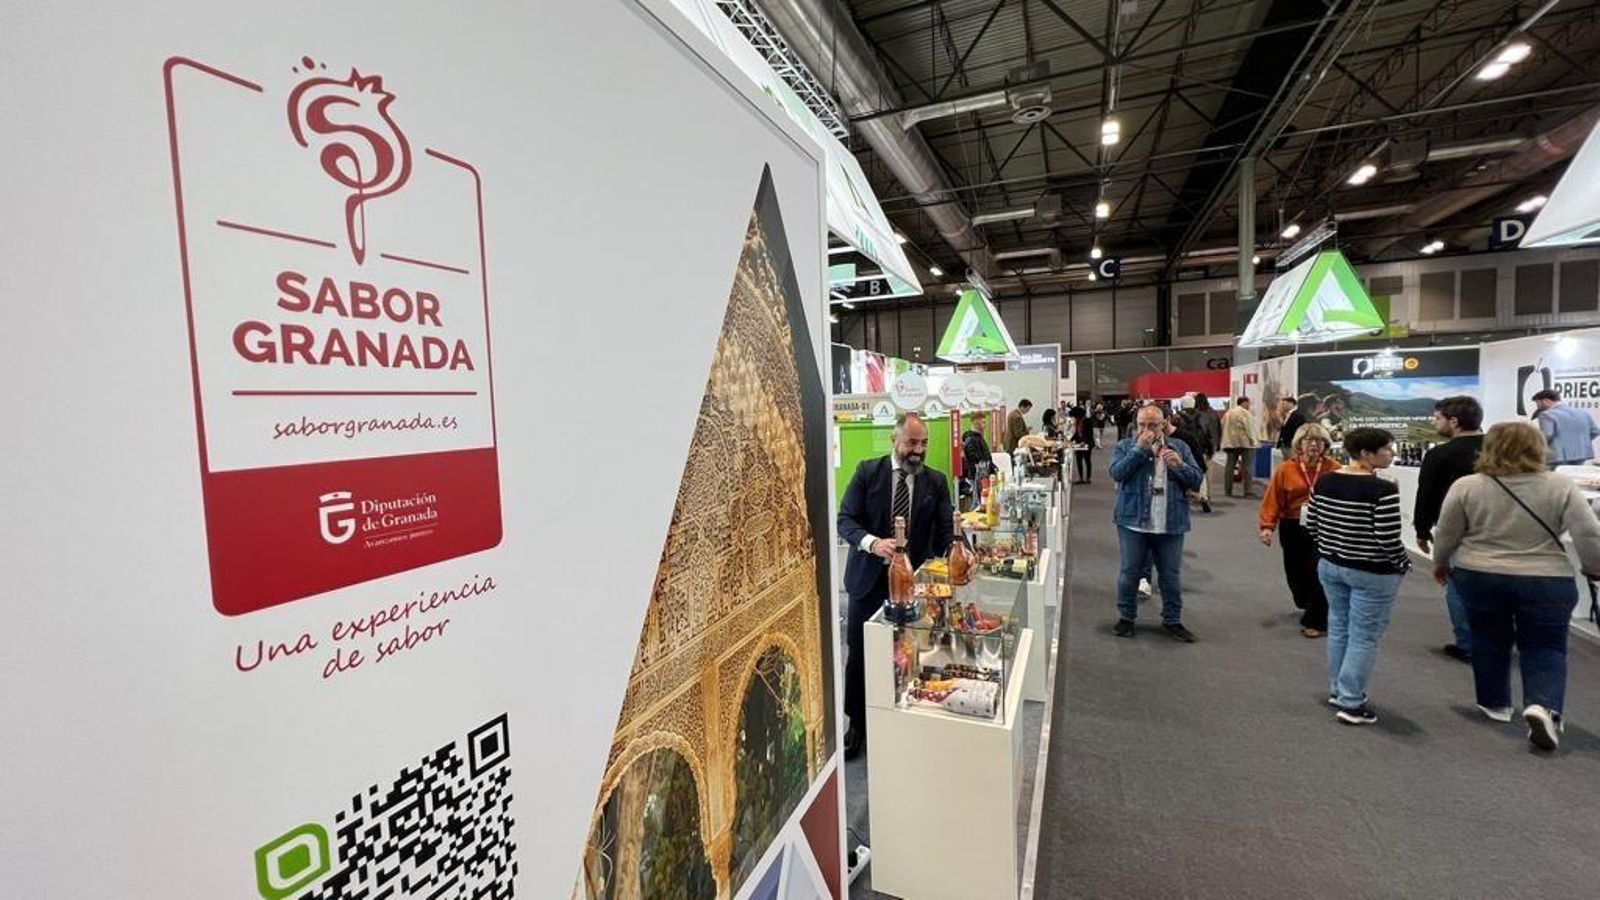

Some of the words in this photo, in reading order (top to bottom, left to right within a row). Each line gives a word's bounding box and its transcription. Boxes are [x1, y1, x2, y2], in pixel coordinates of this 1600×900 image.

[1500, 219, 1524, 242] D
[1099, 258, 1115, 278] C
[276, 271, 442, 328] SABOR
[869, 280, 881, 295] B
[232, 320, 475, 371] GRANADA
[274, 413, 459, 440] saborgranada.es
[361, 492, 437, 516] Diputación
[362, 518, 380, 532] de
[381, 506, 438, 528] Granada
[234, 632, 318, 673] Una
[332, 573, 497, 641] experiencia
[323, 648, 365, 680] de
[377, 617, 451, 663] sabor
